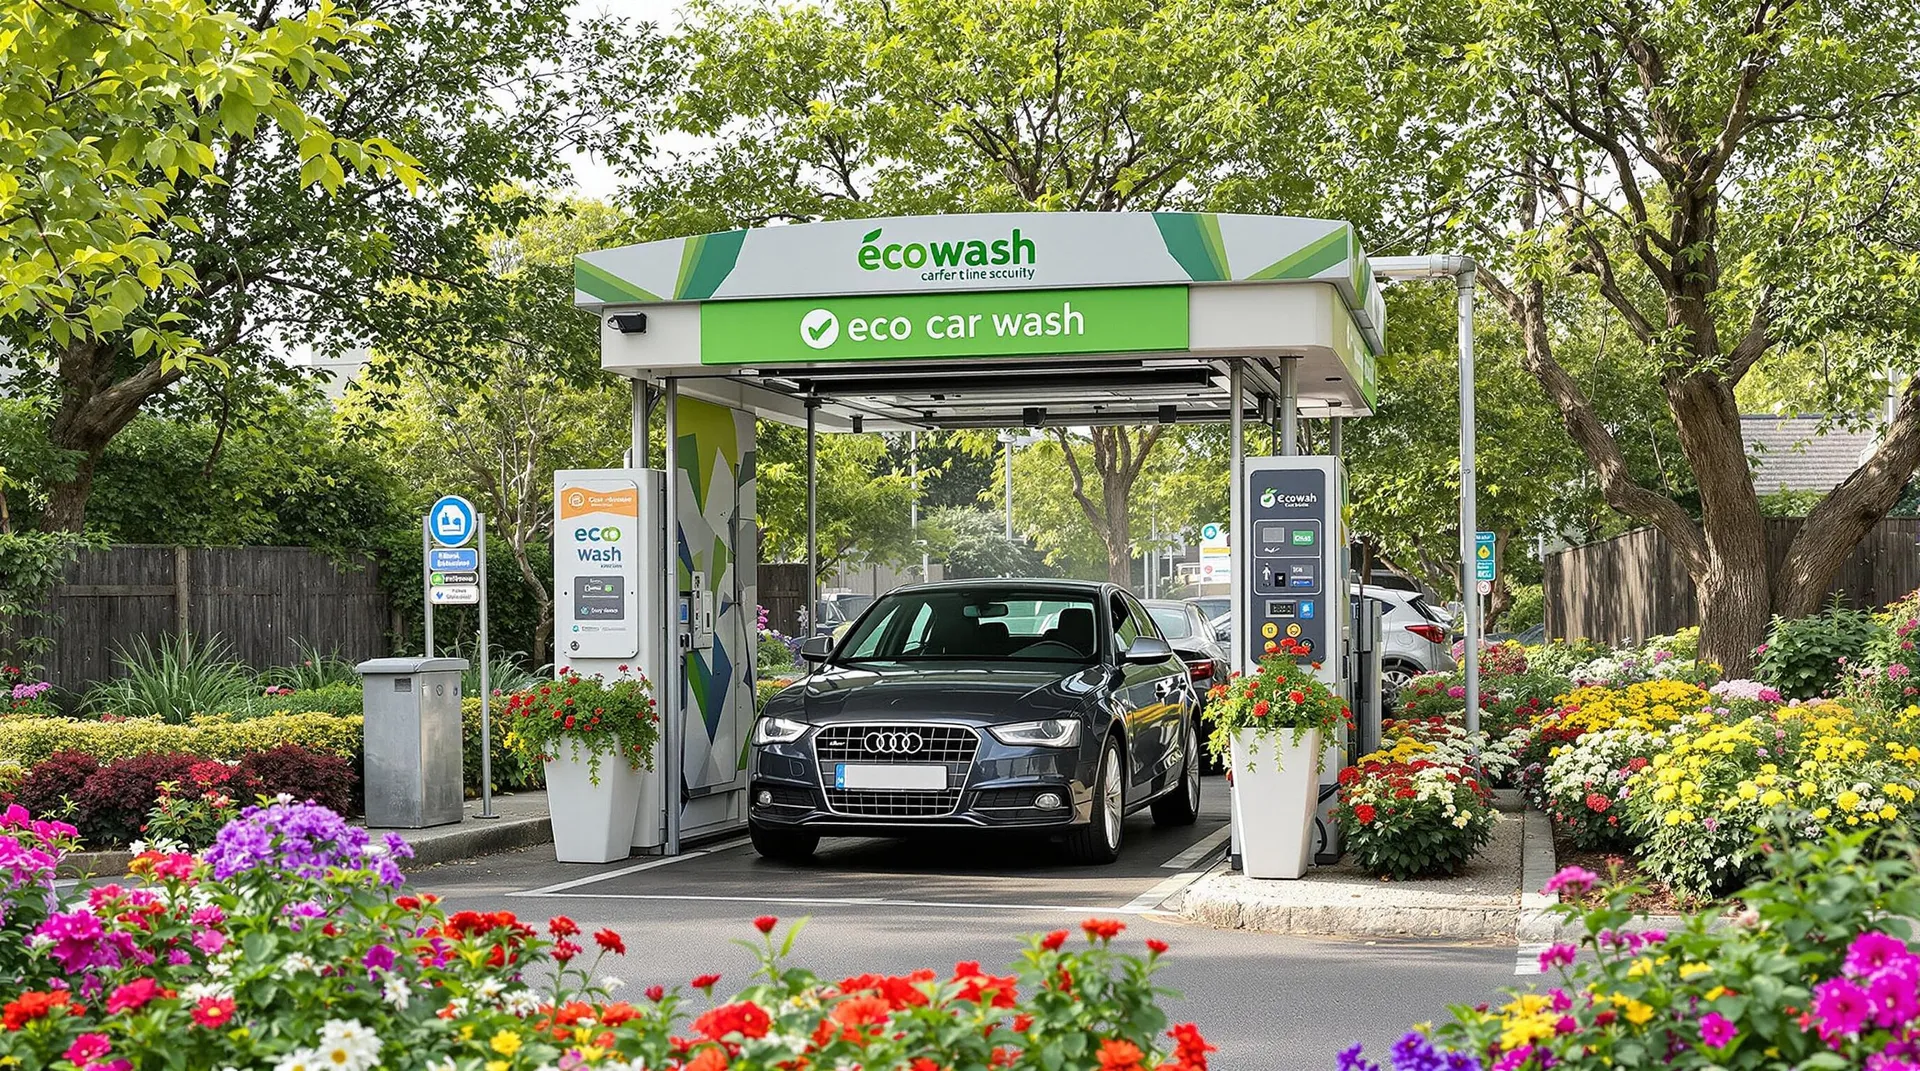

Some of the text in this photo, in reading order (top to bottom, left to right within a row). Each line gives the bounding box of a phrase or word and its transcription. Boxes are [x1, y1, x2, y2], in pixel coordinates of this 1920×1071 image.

[848, 301, 1085, 342] eco car wash
[577, 546, 621, 562] wash
